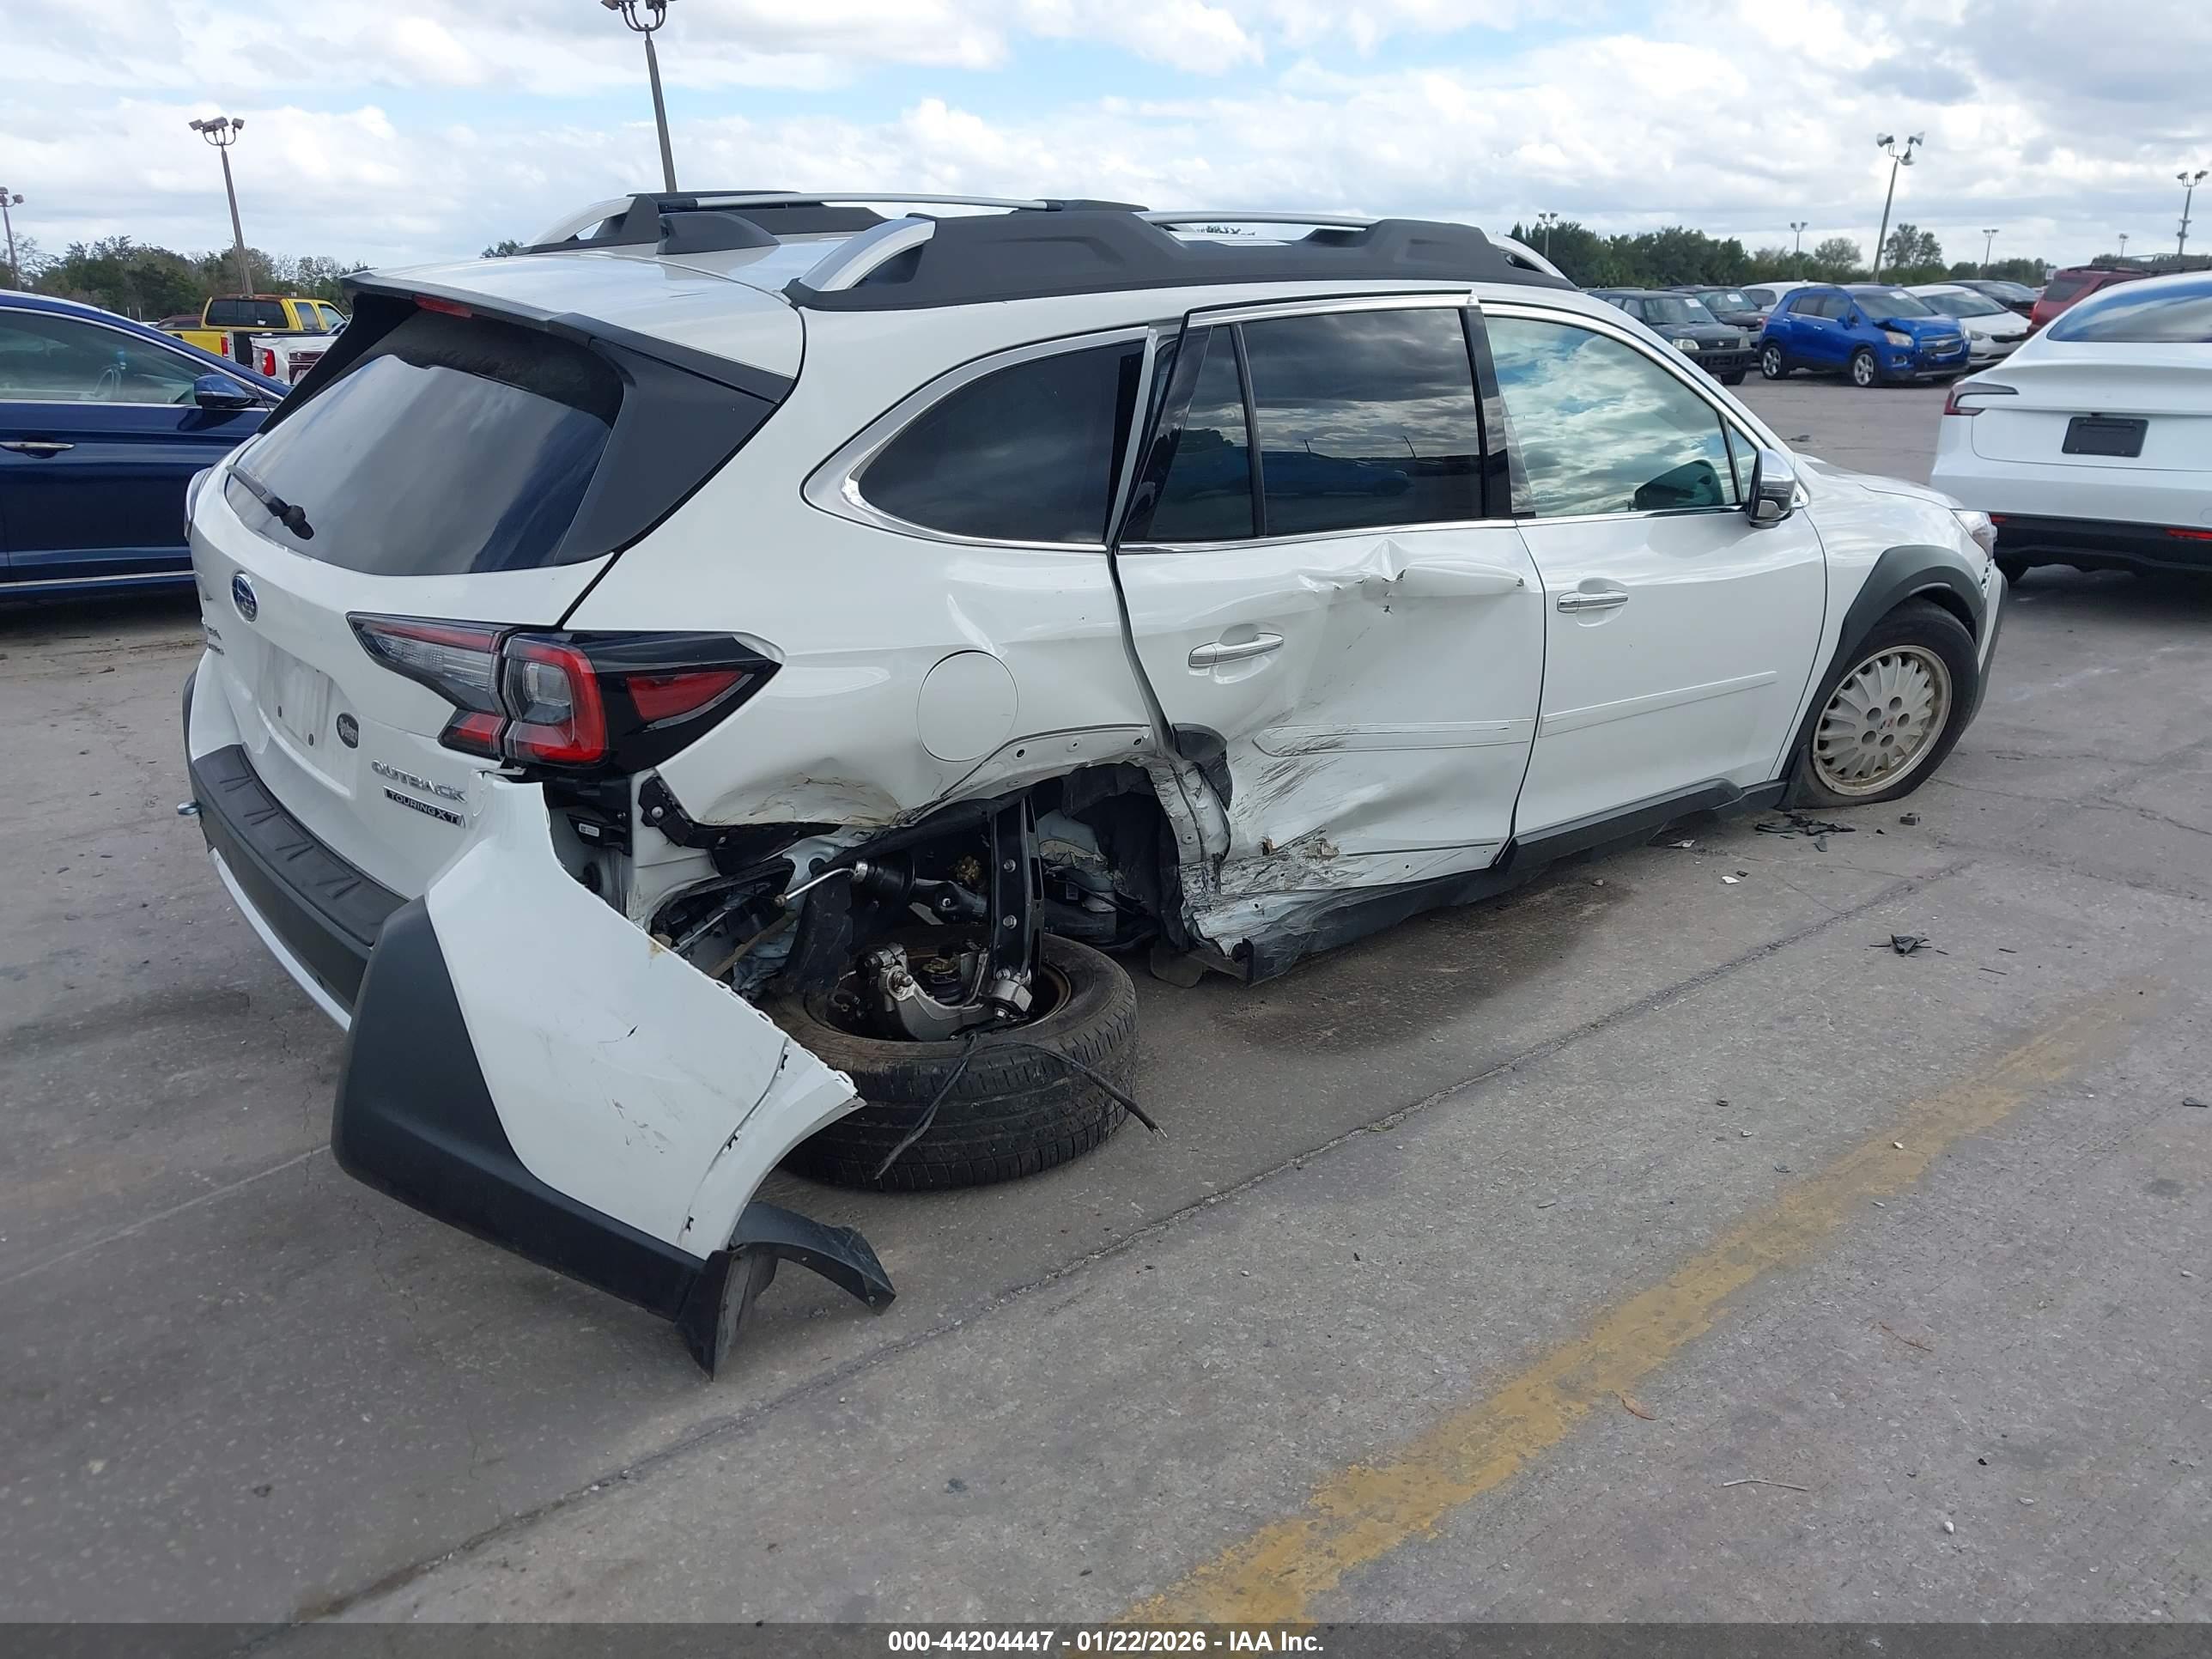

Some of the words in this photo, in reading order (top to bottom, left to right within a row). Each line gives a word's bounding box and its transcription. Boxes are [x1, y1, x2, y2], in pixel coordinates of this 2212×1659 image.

[371, 760, 467, 804] OUTBACK
[390, 791, 436, 815] TOURING
[436, 810, 458, 823] XT
